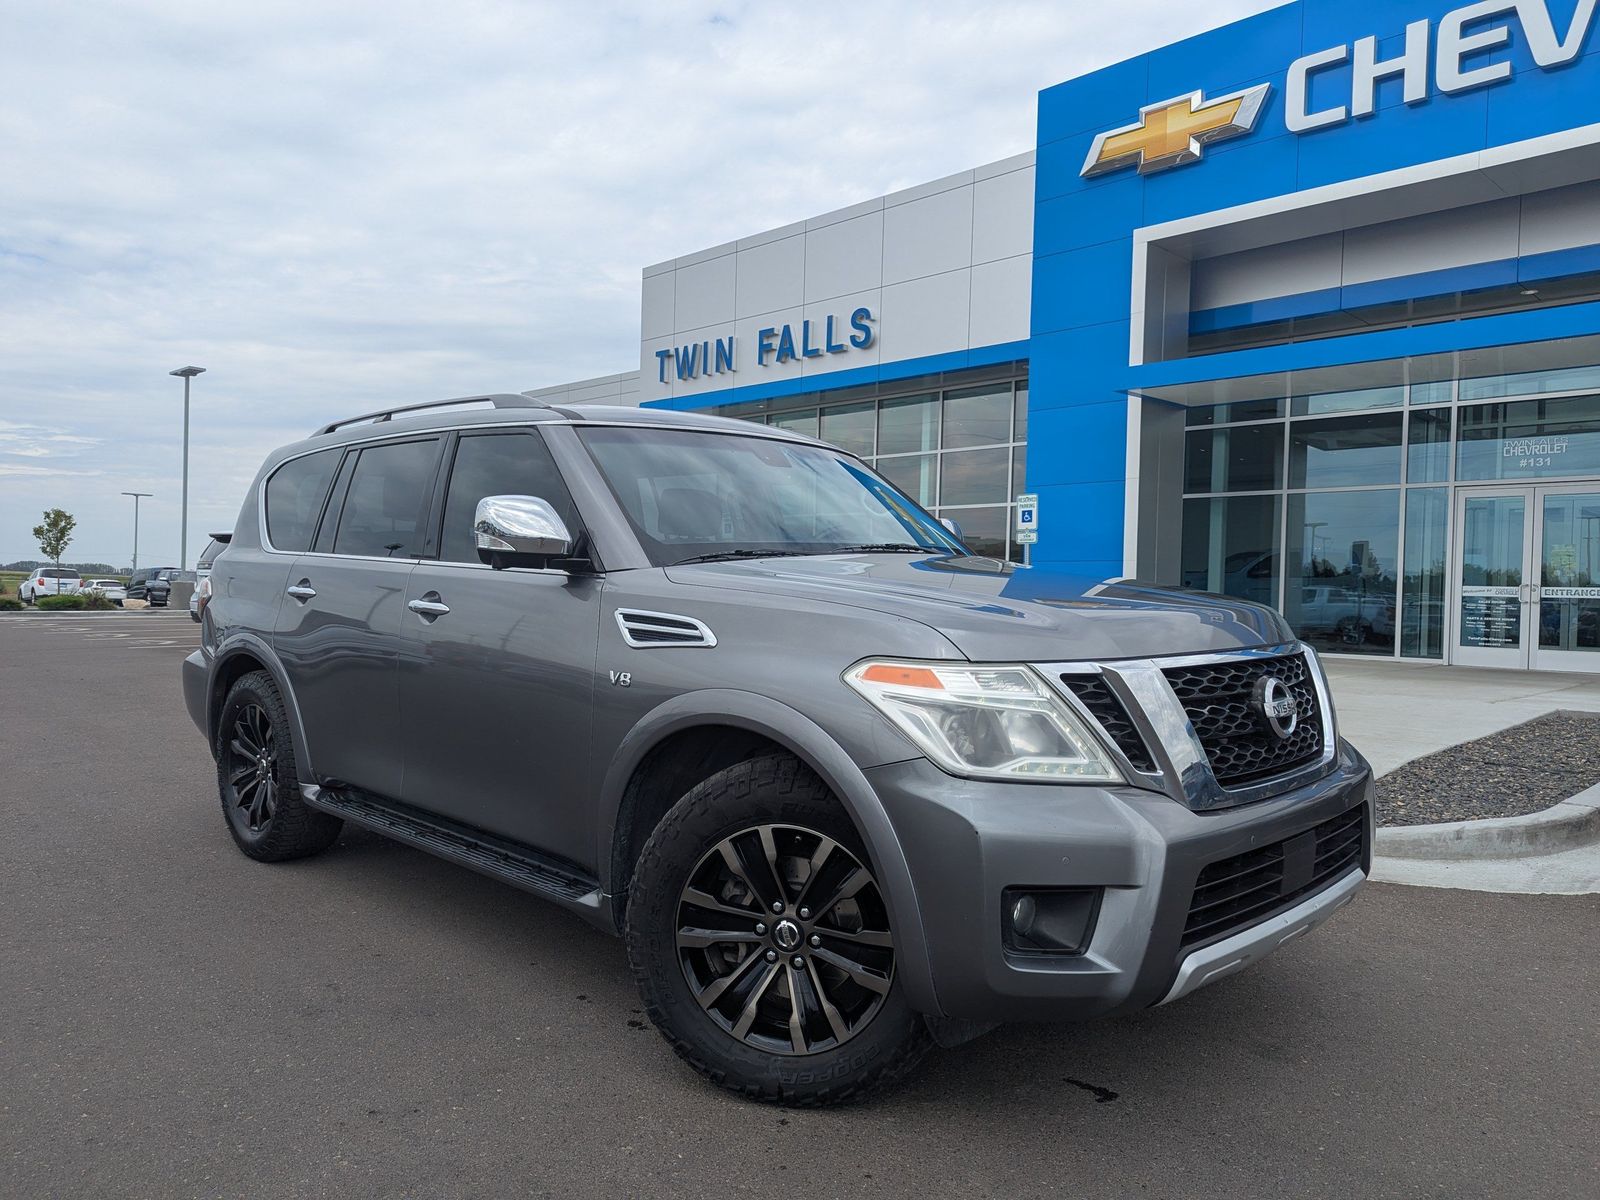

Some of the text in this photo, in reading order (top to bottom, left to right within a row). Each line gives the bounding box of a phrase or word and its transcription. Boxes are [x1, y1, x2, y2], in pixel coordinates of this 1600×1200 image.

[1285, 0, 1598, 133] CHEV
[655, 307, 875, 384] TWIN FALLS
[1503, 443, 1567, 456] CHEVROLET
[1519, 457, 1551, 467] #131
[609, 670, 631, 686] V8
